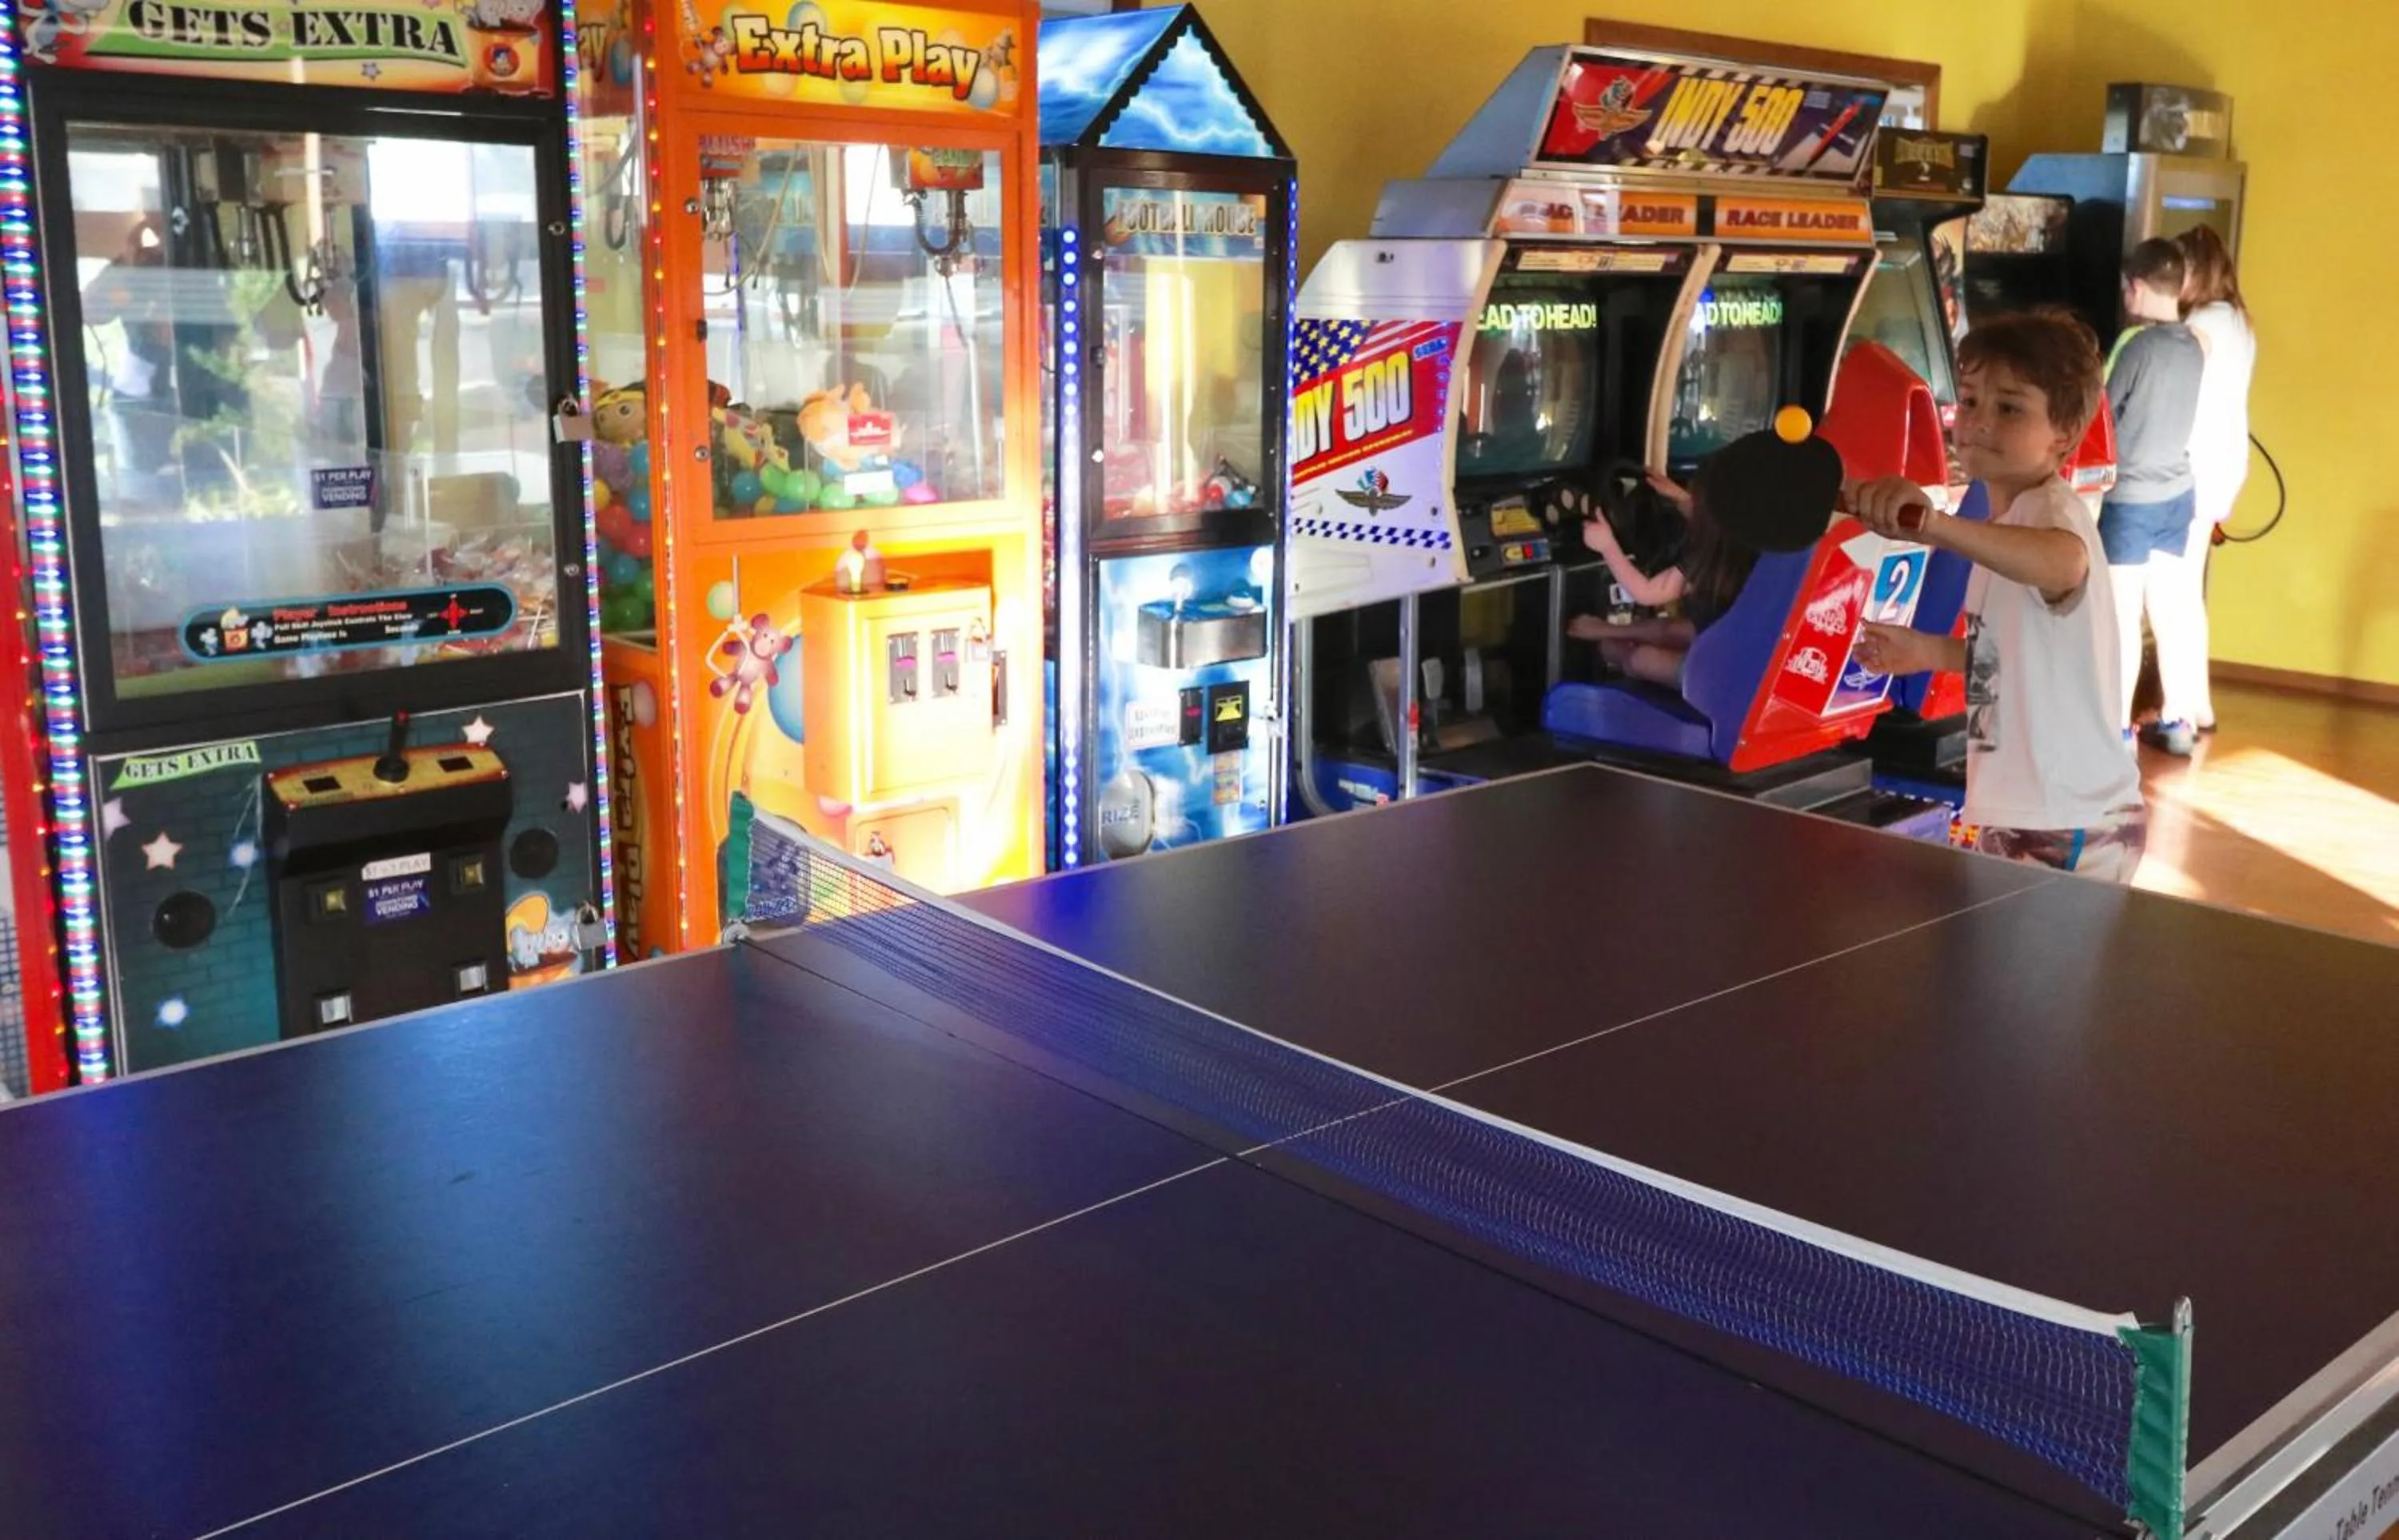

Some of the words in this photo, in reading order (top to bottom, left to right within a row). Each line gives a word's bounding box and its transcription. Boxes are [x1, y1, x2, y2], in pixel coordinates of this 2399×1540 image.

[128, 1, 272, 46] GETS
[289, 10, 460, 57] EXTRA
[577, 22, 608, 82] ay
[732, 14, 872, 81] Extra
[879, 26, 981, 100] Play
[1645, 74, 1746, 150] INDY
[1722, 84, 1806, 155] 500
[1727, 209, 1782, 227] RACE
[1787, 211, 1859, 230] LEADER
[1517, 304, 1545, 329] TO
[1546, 304, 1597, 329] HEAD!
[1342, 351, 1414, 442] 500
[348, 470, 371, 481] PLAY
[1878, 559, 1911, 620] 2
[273, 608, 319, 623] Player
[327, 600, 408, 617] Instructions
[345, 615, 377, 625] Controls
[378, 613, 393, 622] The
[273, 633, 299, 644] Game
[125, 760, 179, 779] GETS
[186, 744, 255, 769] EXTRA
[609, 683, 637, 832] Extra
[401, 879, 423, 892] PLAY
